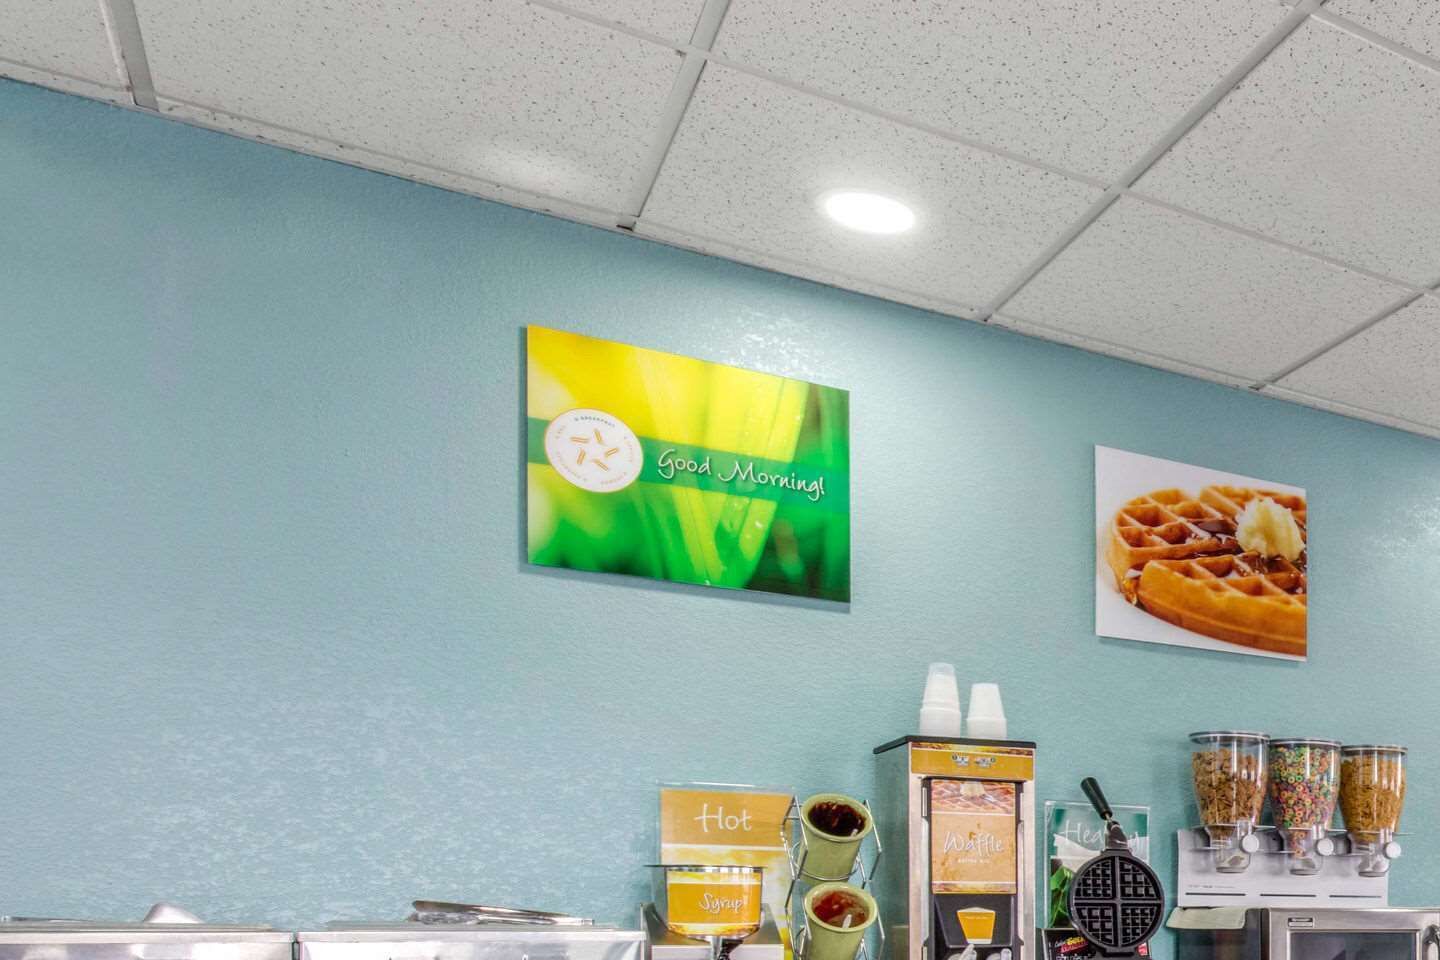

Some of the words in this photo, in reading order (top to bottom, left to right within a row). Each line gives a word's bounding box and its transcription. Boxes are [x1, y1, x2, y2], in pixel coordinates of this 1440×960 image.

[658, 449, 711, 479] Good
[718, 462, 825, 501] Morning!
[693, 803, 752, 832] Hot
[944, 831, 1004, 856] Waffle
[699, 892, 744, 914] Syrup
